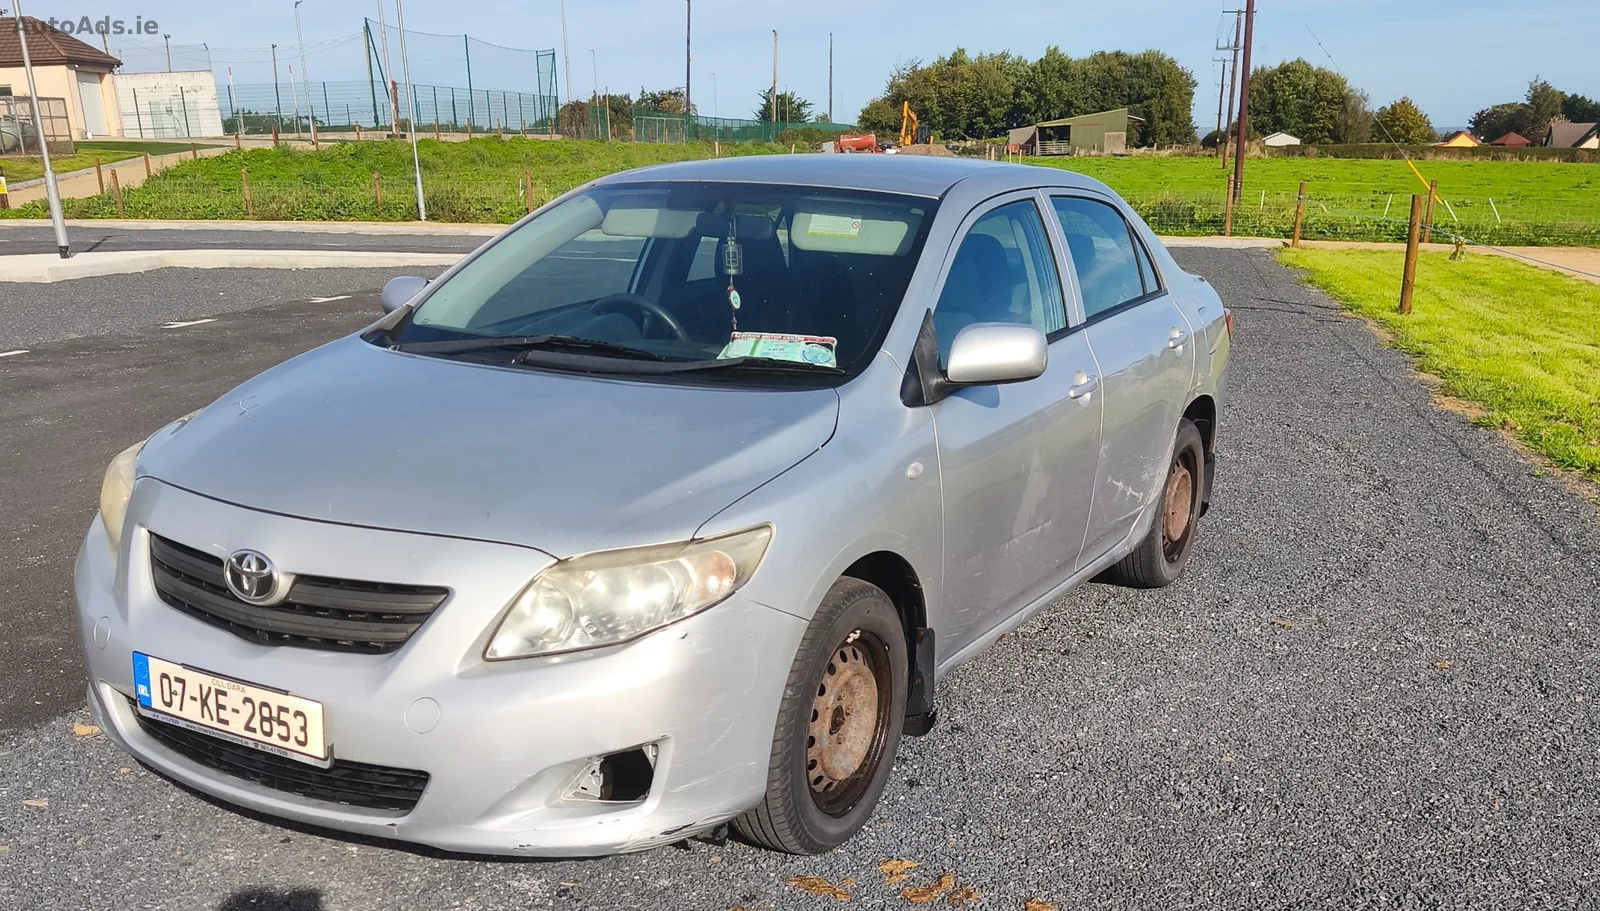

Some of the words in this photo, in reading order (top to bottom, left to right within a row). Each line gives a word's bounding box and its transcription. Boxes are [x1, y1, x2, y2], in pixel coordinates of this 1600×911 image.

[138, 683, 150, 698] IRL
[211, 678, 226, 689] CILL
[227, 682, 246, 694] DARA
[159, 672, 308, 747] 07-KE-2853
